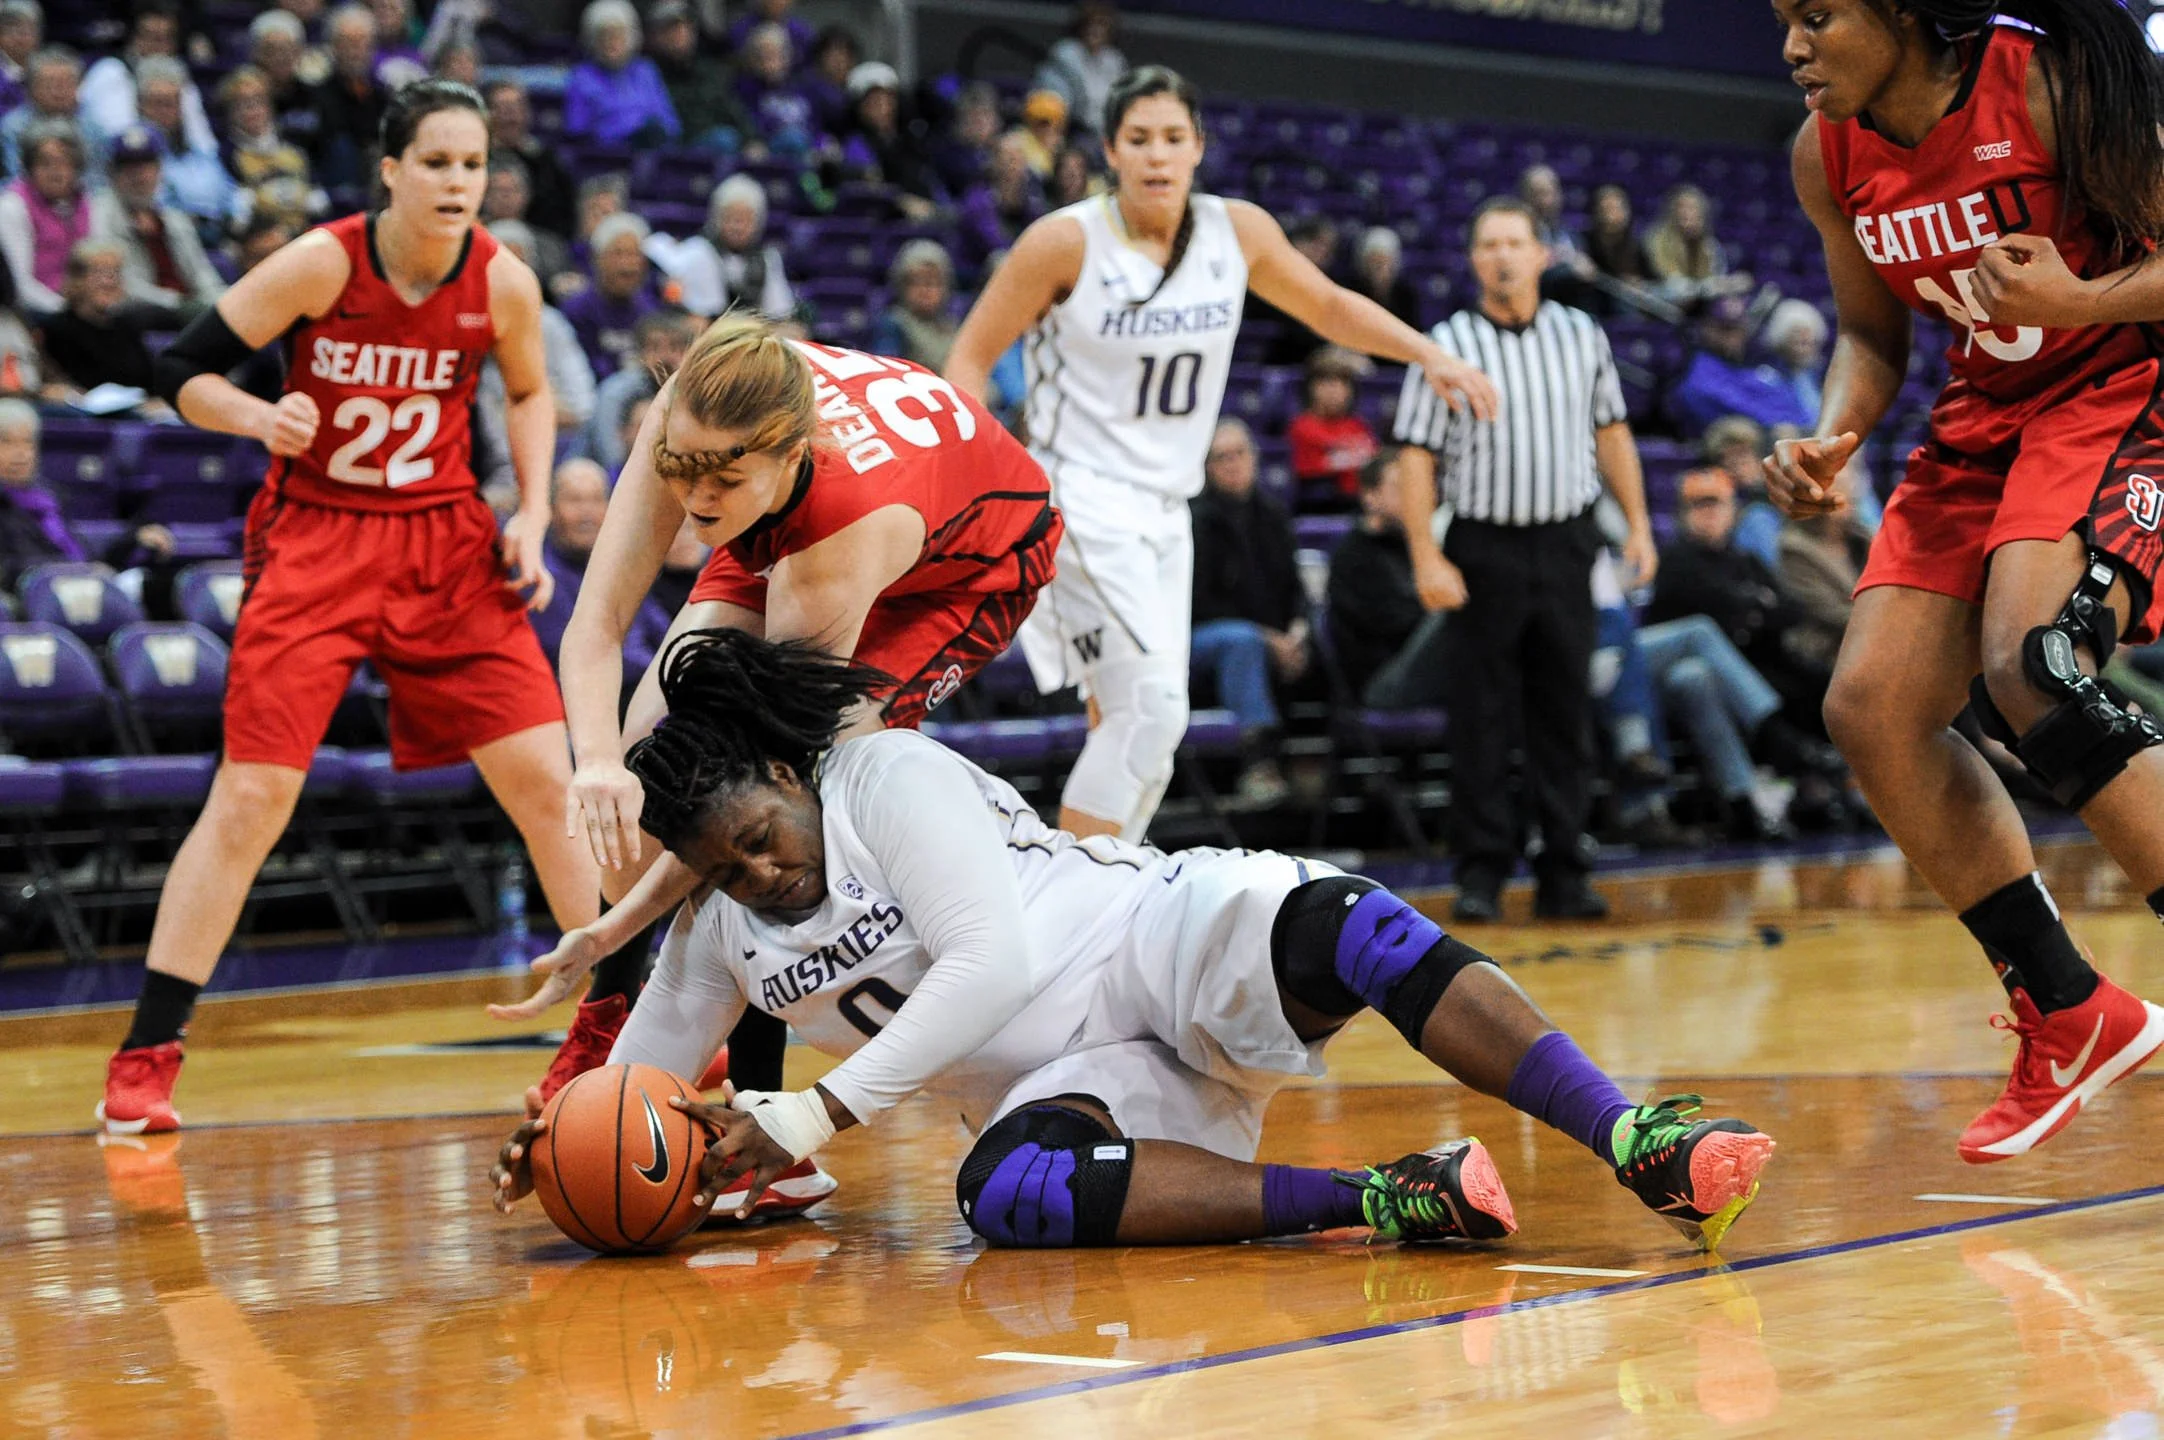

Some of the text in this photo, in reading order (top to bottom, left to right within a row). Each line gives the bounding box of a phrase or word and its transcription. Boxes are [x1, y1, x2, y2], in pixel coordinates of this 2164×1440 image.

[1974, 140, 2012, 161] WAC
[1100, 301, 1233, 336] HUSKIES
[1136, 353, 1202, 418] 10
[326, 393, 441, 488] 22
[1073, 628, 1102, 664] W
[761, 902, 904, 1012] HUSKIES
